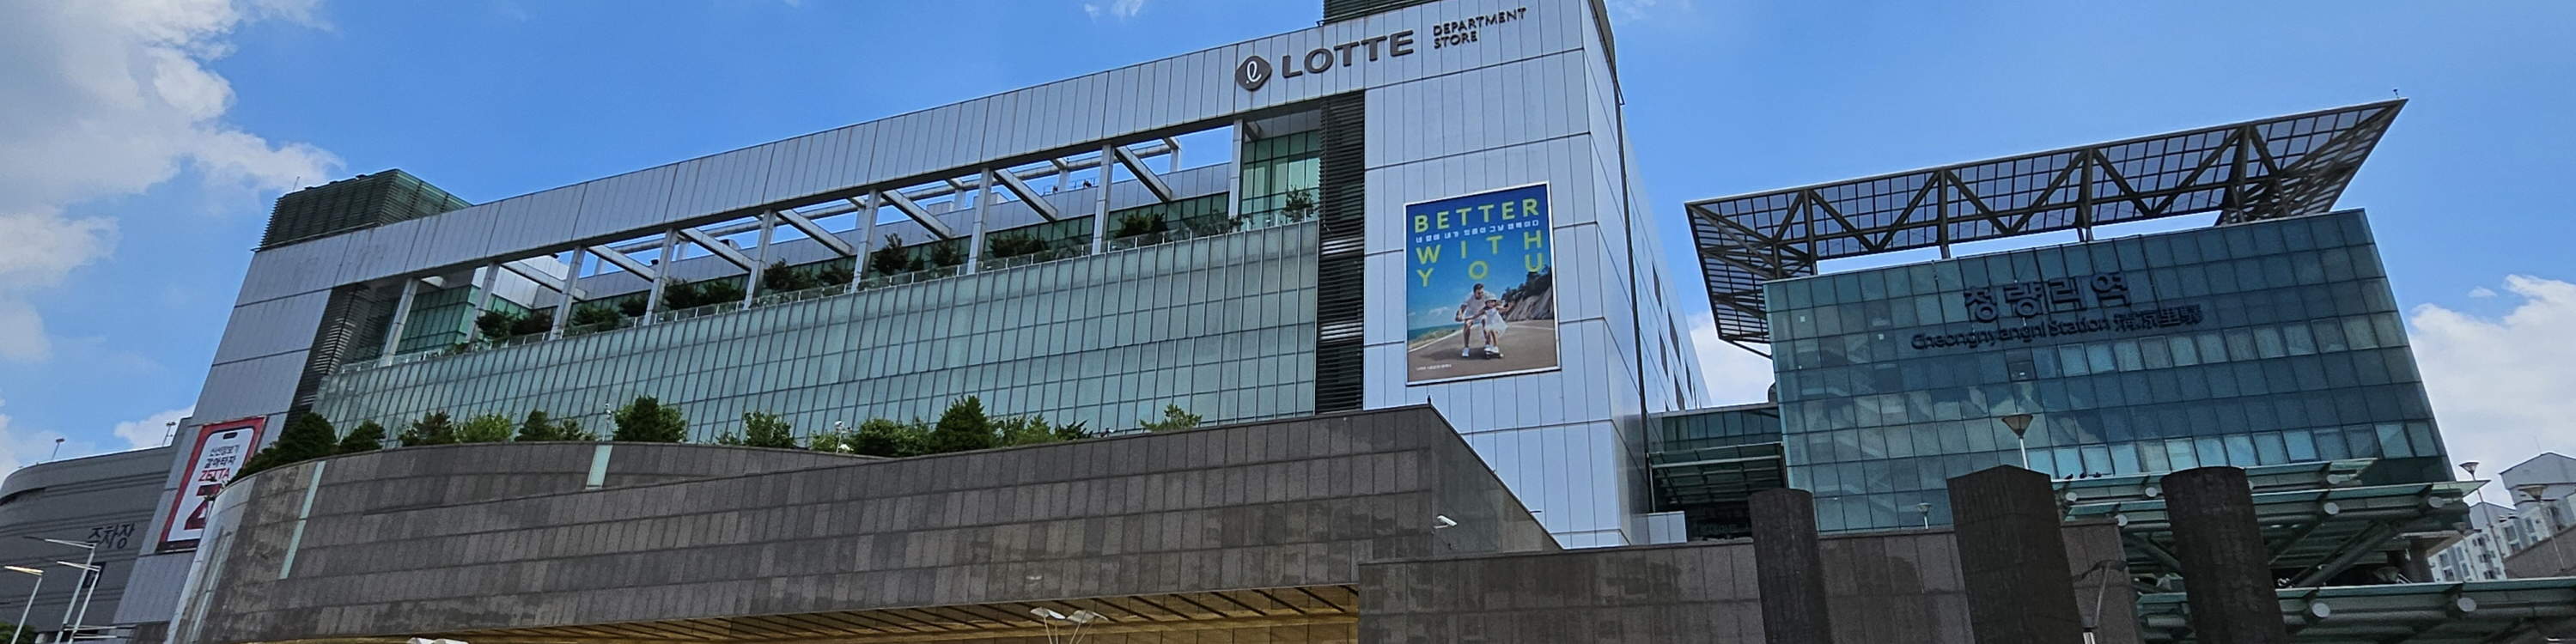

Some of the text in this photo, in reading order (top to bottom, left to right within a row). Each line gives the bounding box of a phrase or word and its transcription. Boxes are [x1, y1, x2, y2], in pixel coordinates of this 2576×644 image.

[1433, 8, 1526, 37] DEPARTMENT
[1282, 30, 1414, 78] LOTTE
[1434, 31, 1478, 49] STORE
[1415, 198, 1539, 234] BETTER
[1416, 229, 1543, 264] WITH
[1416, 252, 1544, 288] YOU
[1964, 271, 2131, 323] 청량리역
[2049, 317, 2111, 337] Station
[198, 468, 230, 482] ZETTA
[88, 523, 135, 550] 주차장
